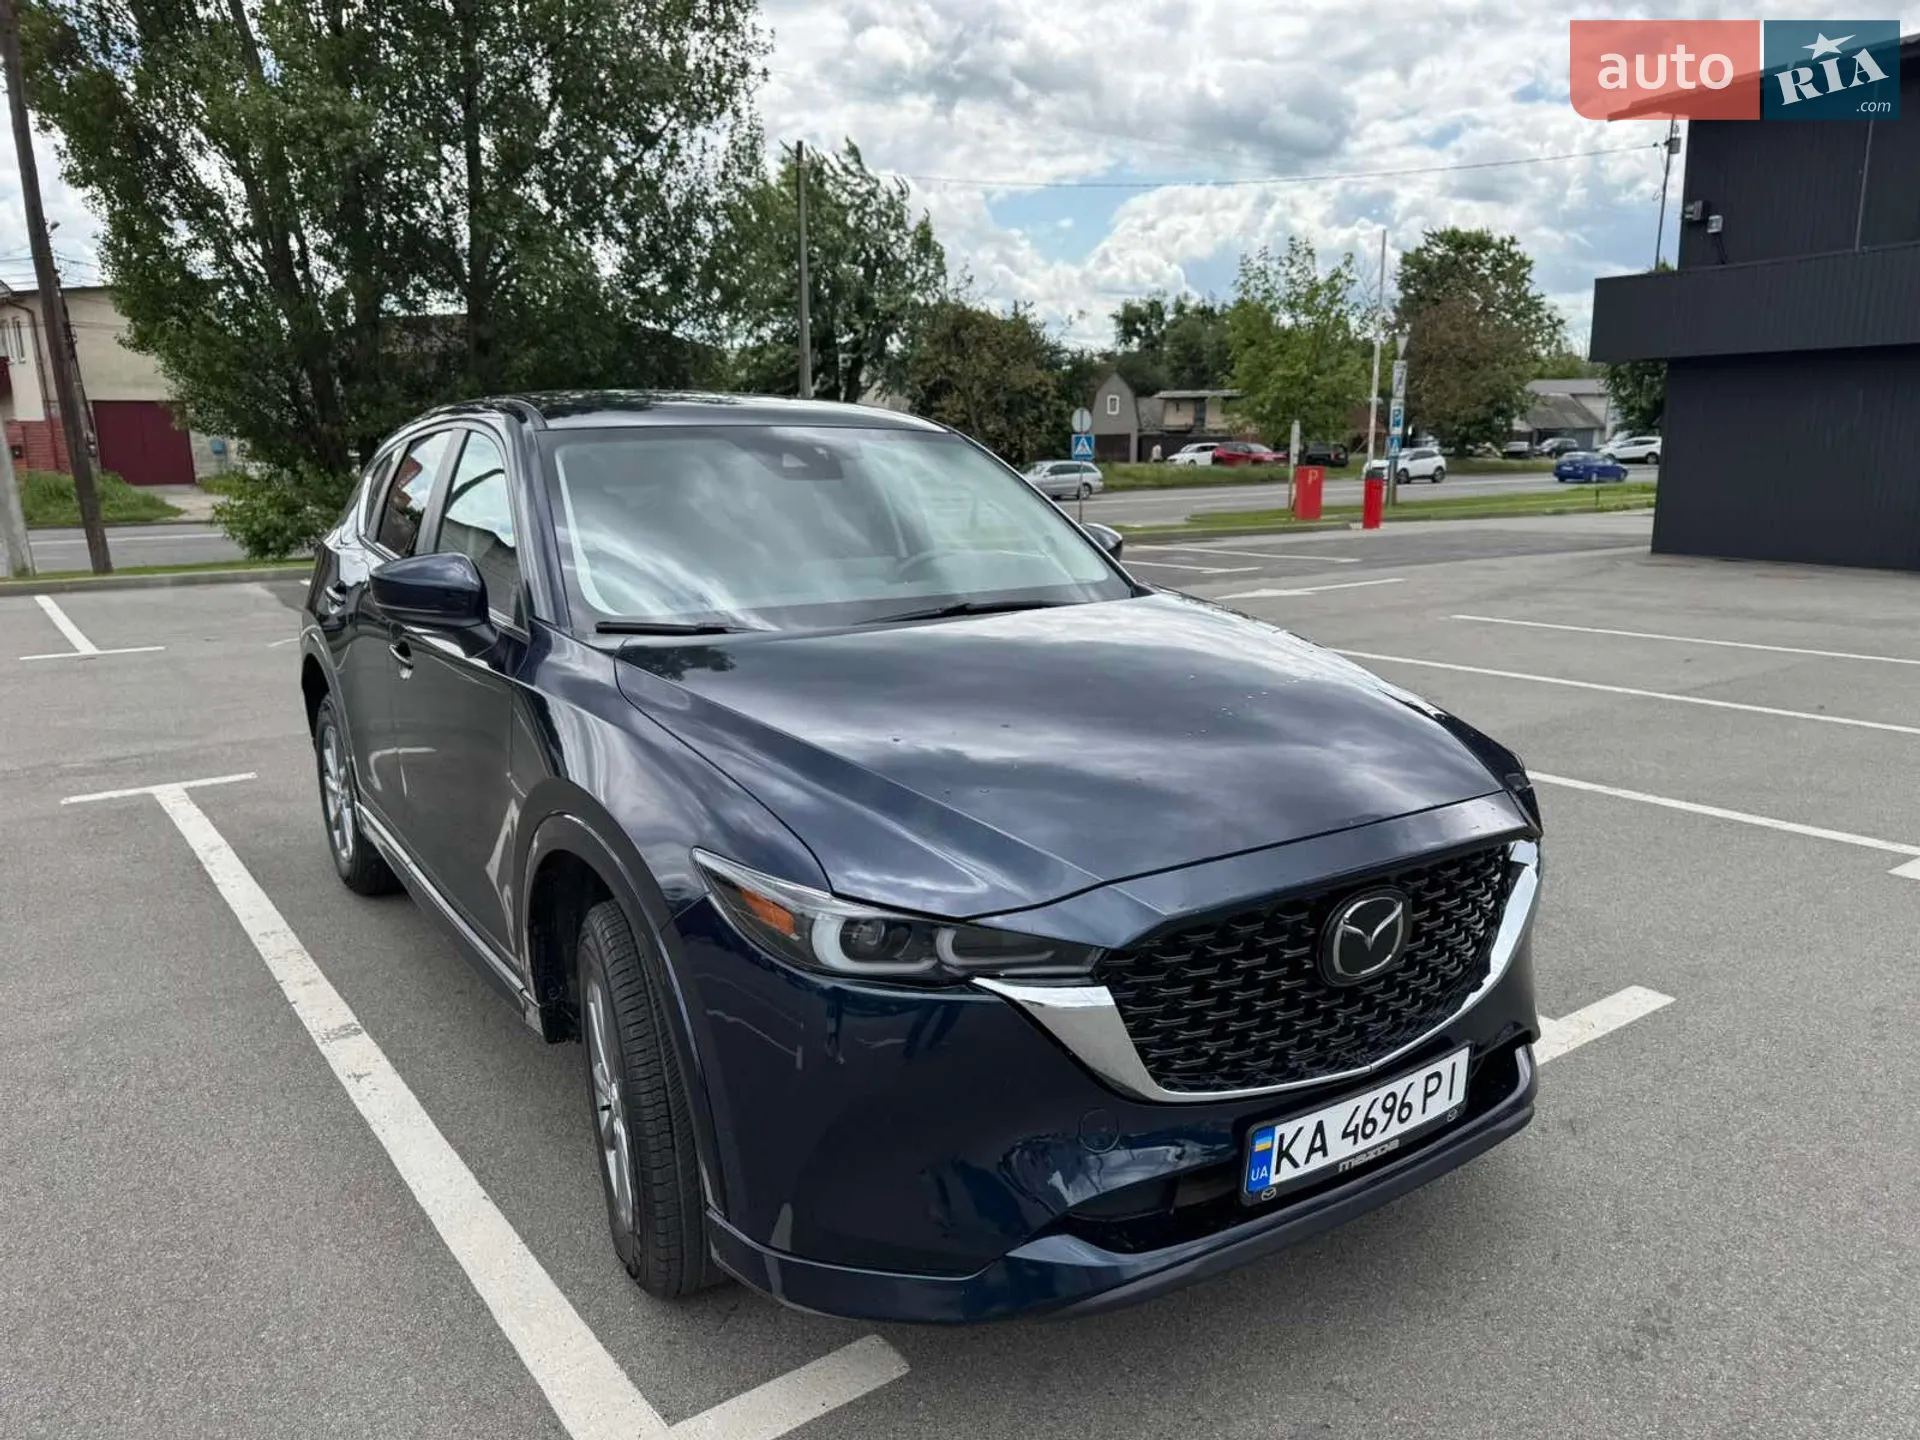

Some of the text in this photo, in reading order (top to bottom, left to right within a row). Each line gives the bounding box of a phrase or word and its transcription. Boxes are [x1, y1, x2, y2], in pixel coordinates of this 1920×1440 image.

[1275, 1062, 1456, 1175] KA 4696 PI
[1251, 1165, 1268, 1181] UA
